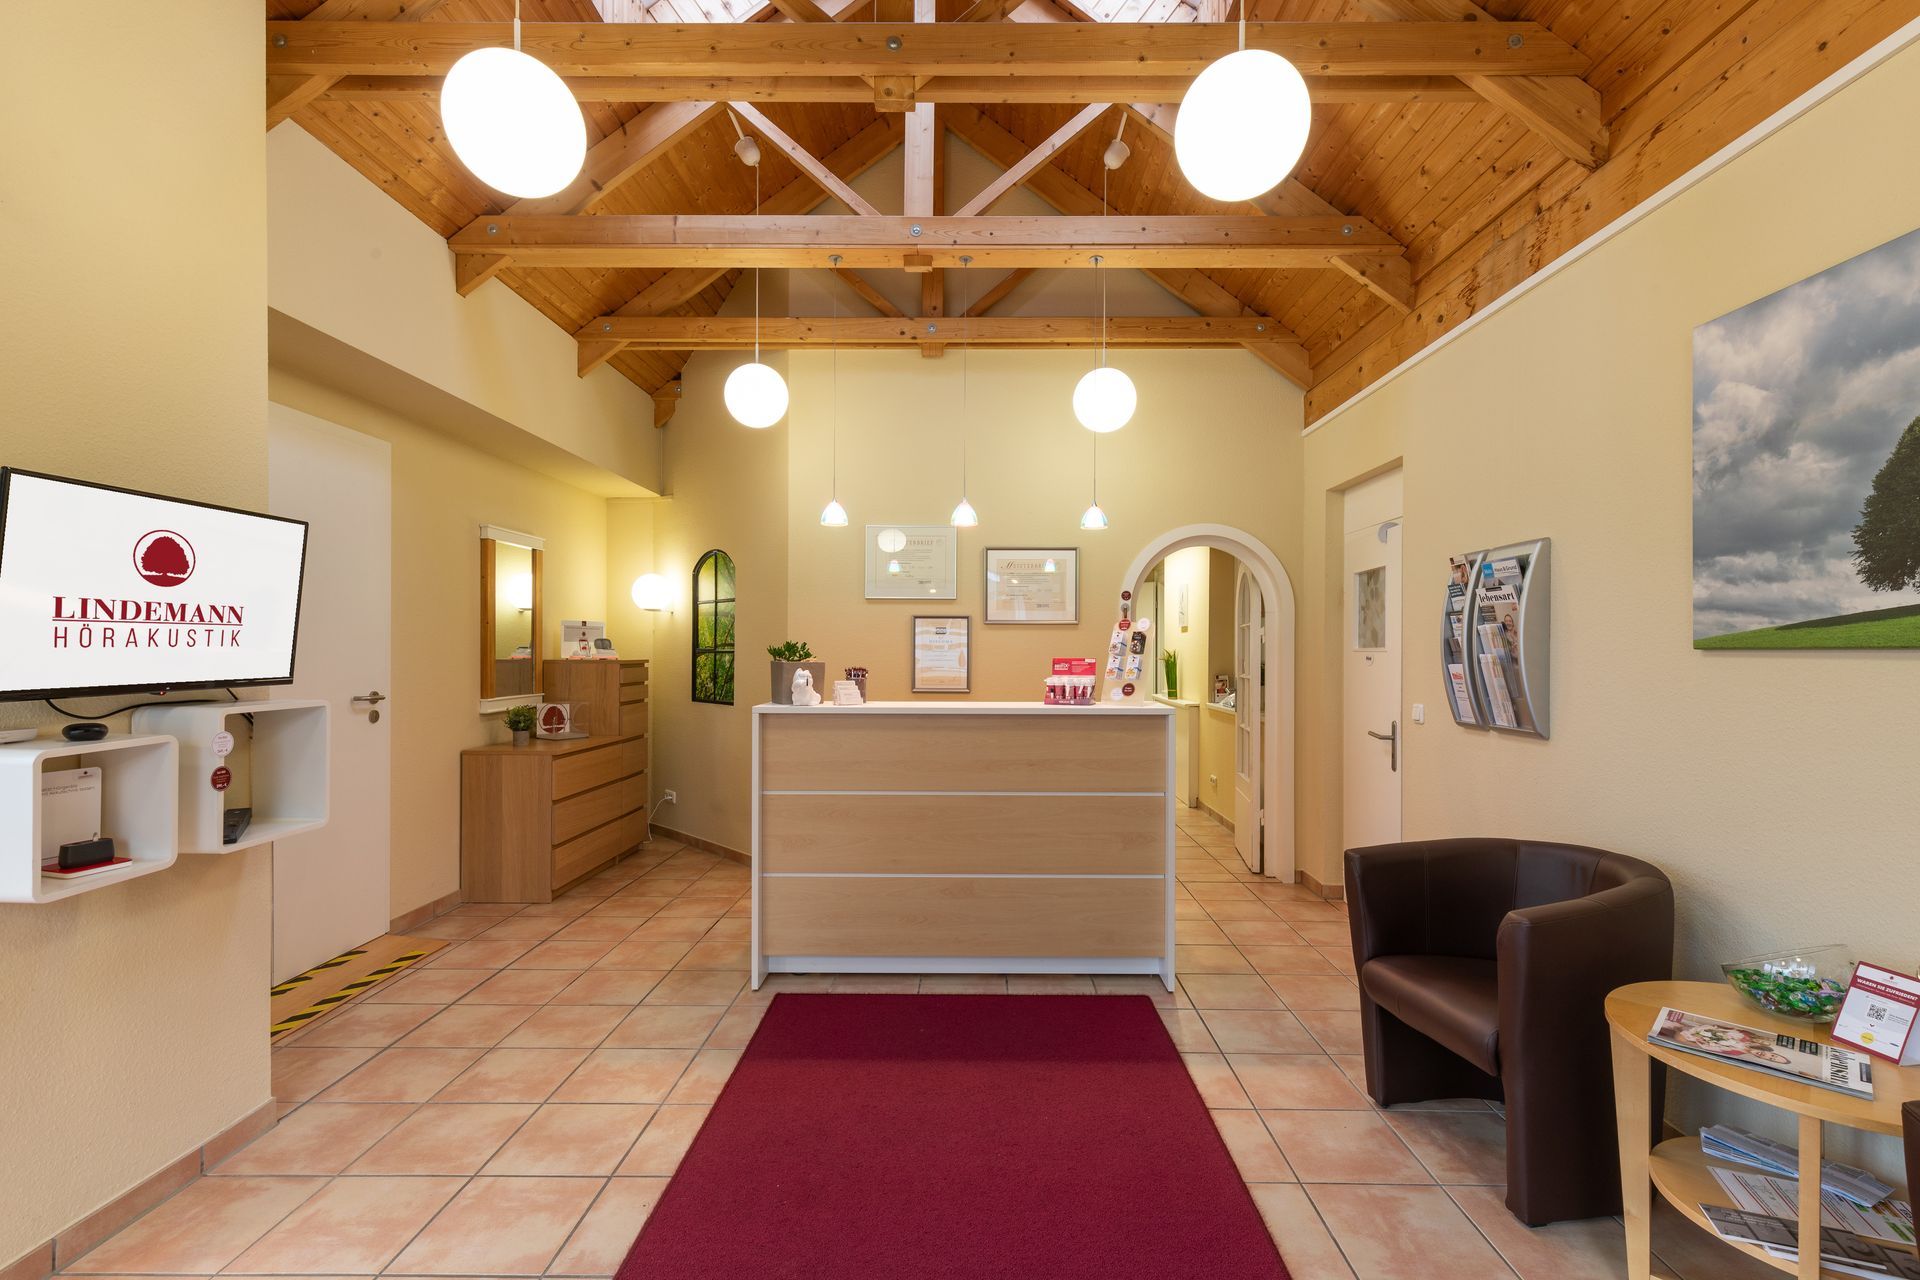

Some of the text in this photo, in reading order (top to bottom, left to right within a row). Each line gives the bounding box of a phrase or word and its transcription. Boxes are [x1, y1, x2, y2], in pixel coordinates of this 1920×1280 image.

[52, 595, 244, 624] LINDEMANN
[1478, 592, 1515, 603] lebensart
[54, 623, 241, 648] HÖRAKUSTIK
[1857, 978, 1877, 988] WAREN
[1886, 987, 1918, 1001] ZUFRIEDEN?
